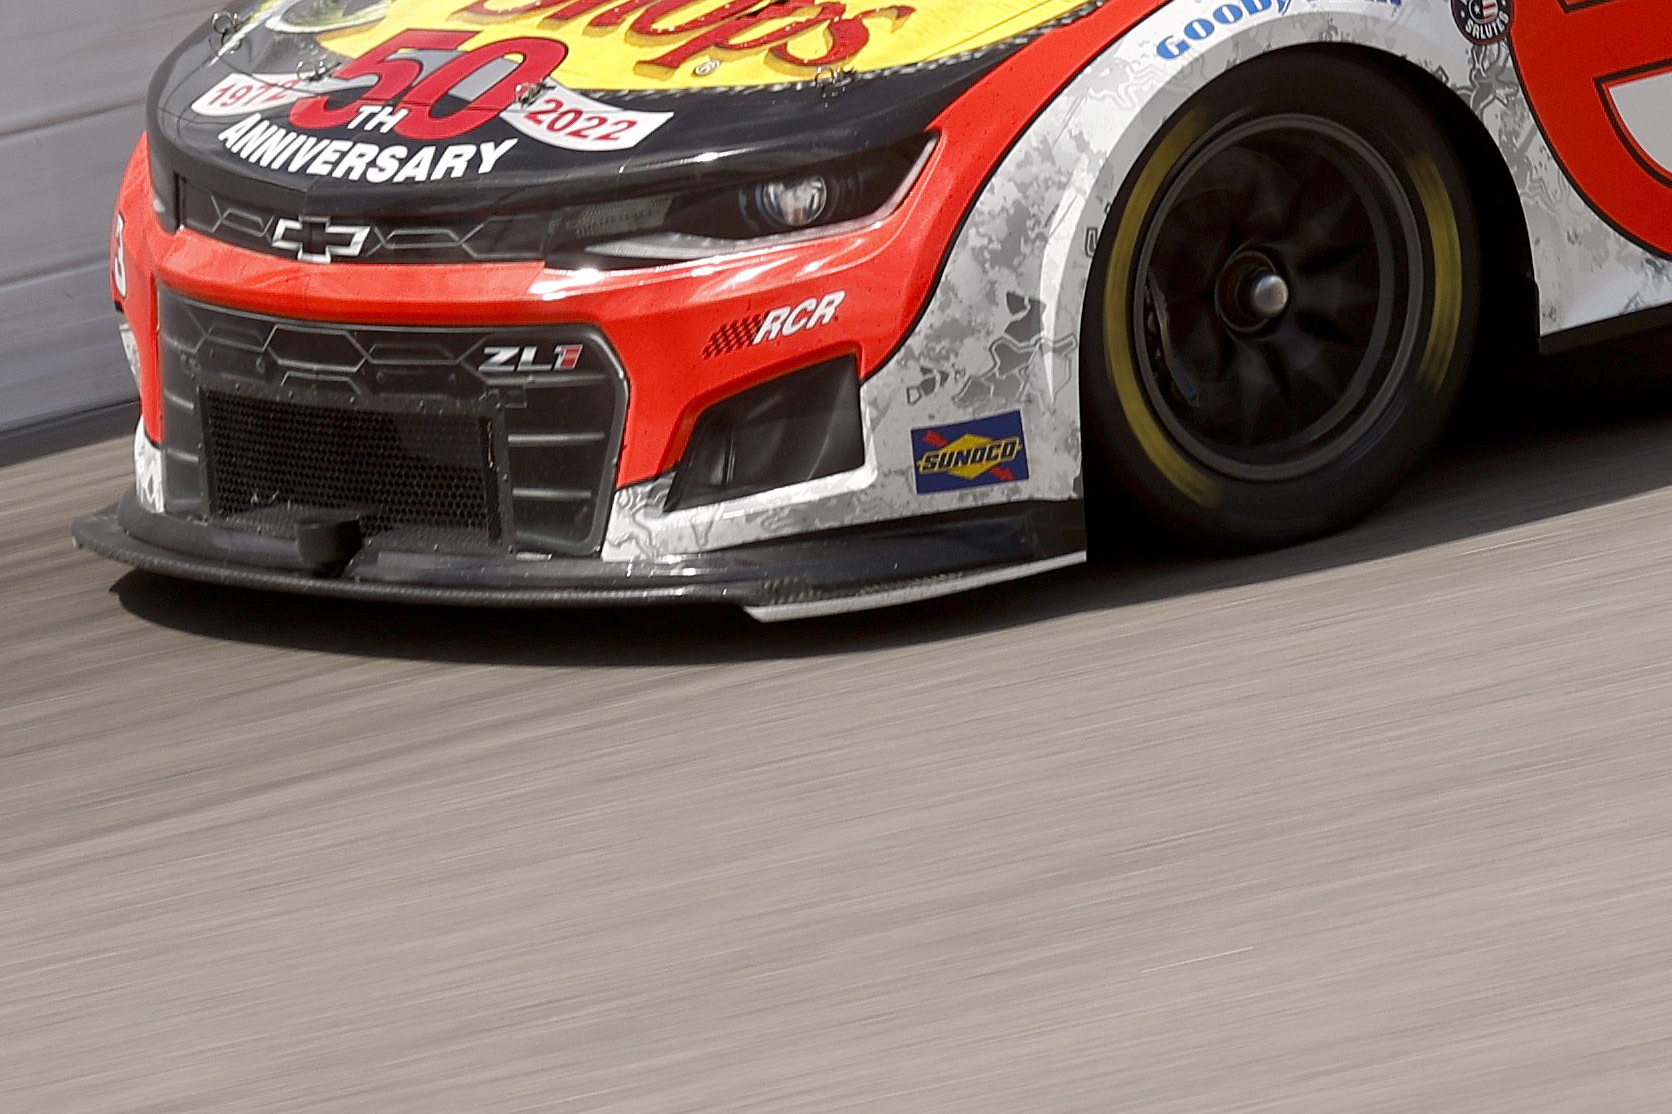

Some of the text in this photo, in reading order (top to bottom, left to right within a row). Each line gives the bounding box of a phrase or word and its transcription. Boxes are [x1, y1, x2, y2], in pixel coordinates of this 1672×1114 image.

[1464, 11, 1509, 40] SALUTES
[288, 28, 569, 140] 50
[346, 104, 409, 134] TH
[522, 96, 638, 144] 2022
[217, 112, 519, 185] ANNIVERSARY
[752, 290, 846, 346] RCR
[478, 344, 584, 371] ZL1
[920, 439, 1019, 472] SUNOCO
